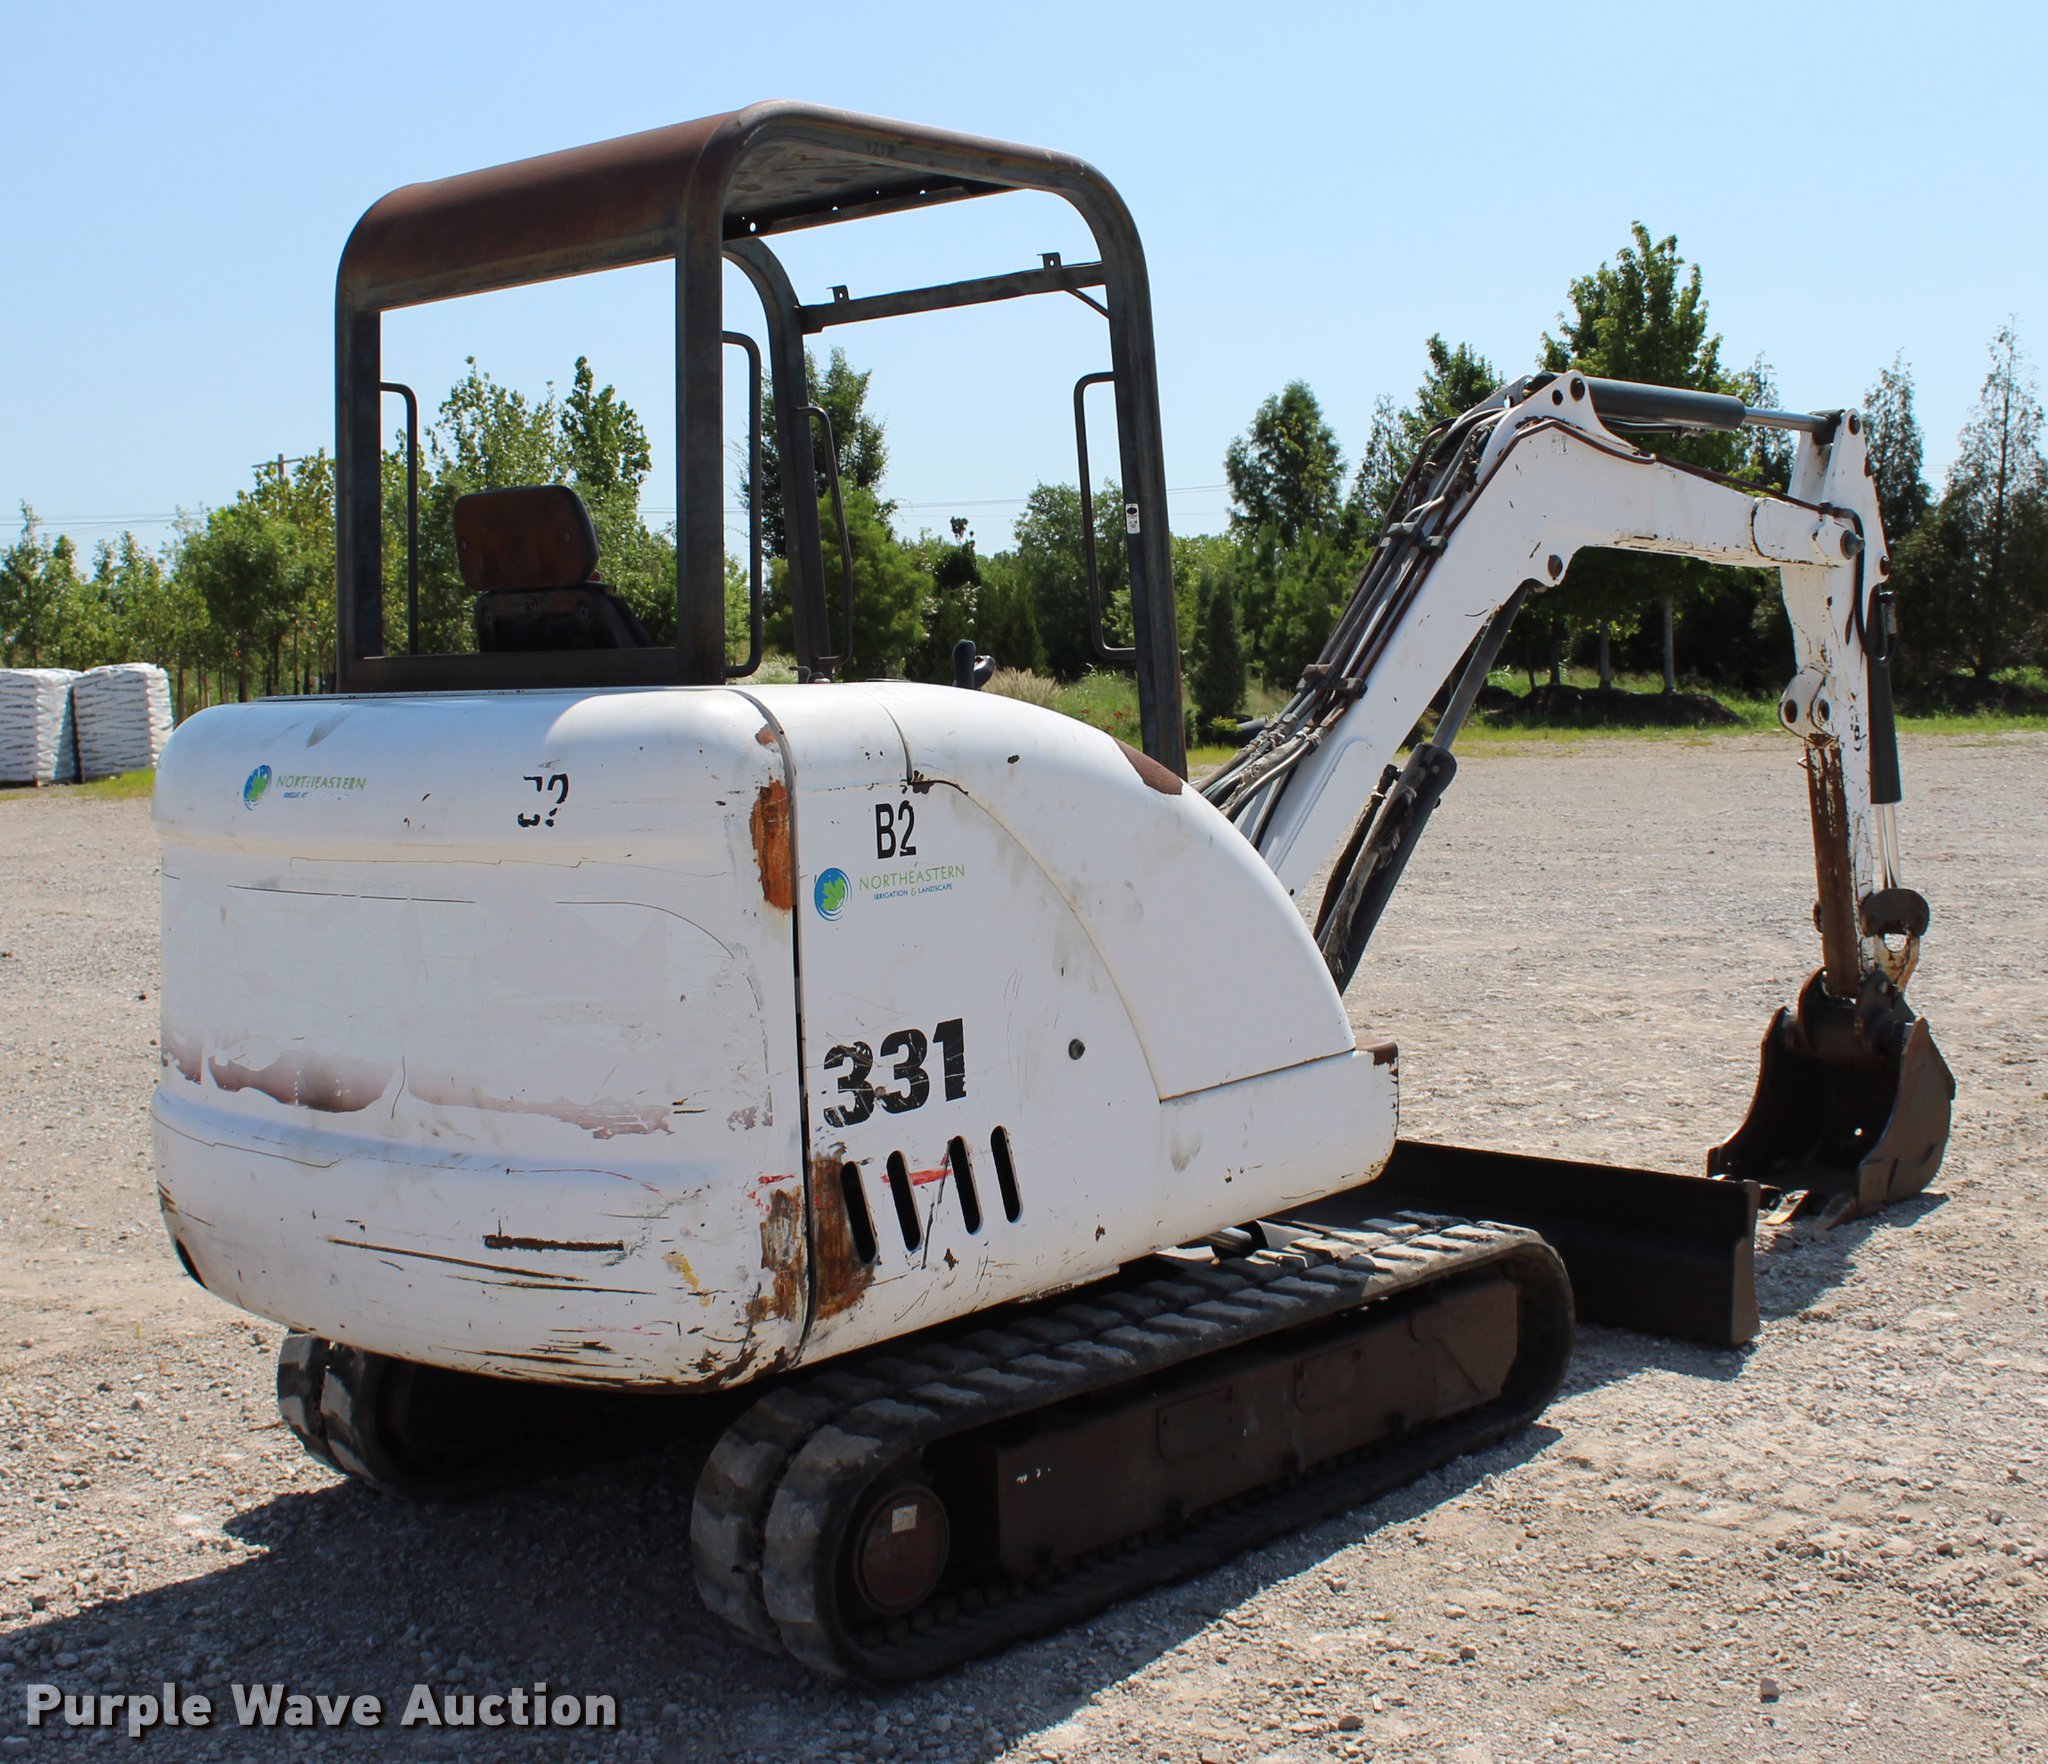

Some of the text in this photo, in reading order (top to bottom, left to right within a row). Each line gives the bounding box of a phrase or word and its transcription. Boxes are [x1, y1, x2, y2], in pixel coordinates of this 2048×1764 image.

[875, 799, 917, 860] B2
[859, 864, 965, 891] NORTHEASTERN
[873, 890, 909, 900] IRRIGATION
[918, 883, 953, 894] LANDSCAPE
[823, 1018, 967, 1128] 331
